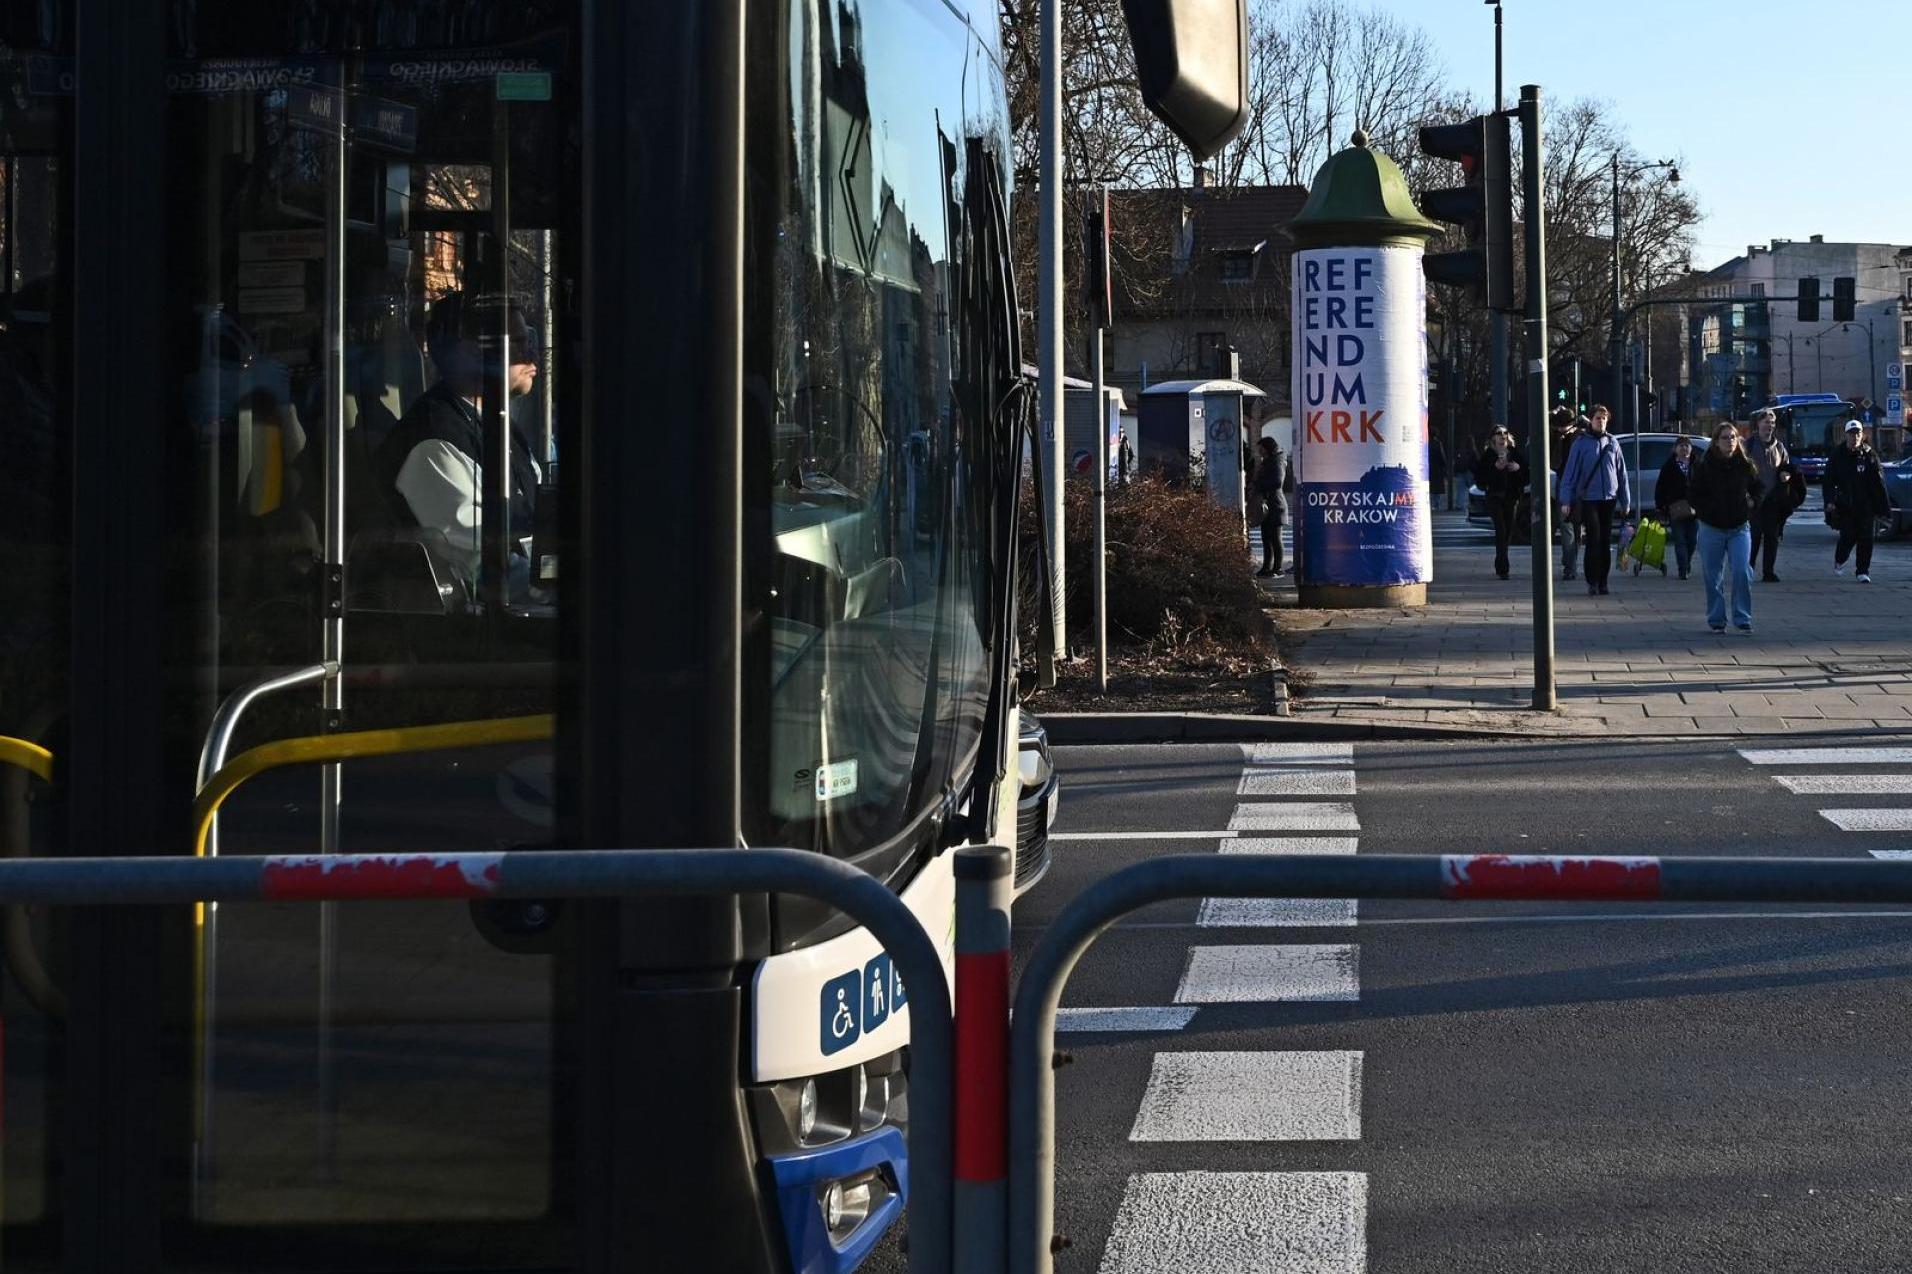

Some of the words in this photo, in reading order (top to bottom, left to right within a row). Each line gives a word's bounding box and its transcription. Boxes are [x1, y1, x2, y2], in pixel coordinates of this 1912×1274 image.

[1305, 259, 1373, 292] REF
[1306, 296, 1374, 329] ERE
[1306, 334, 1365, 368] ND
[1306, 372, 1367, 406] UM
[1306, 410, 1386, 444] KRK
